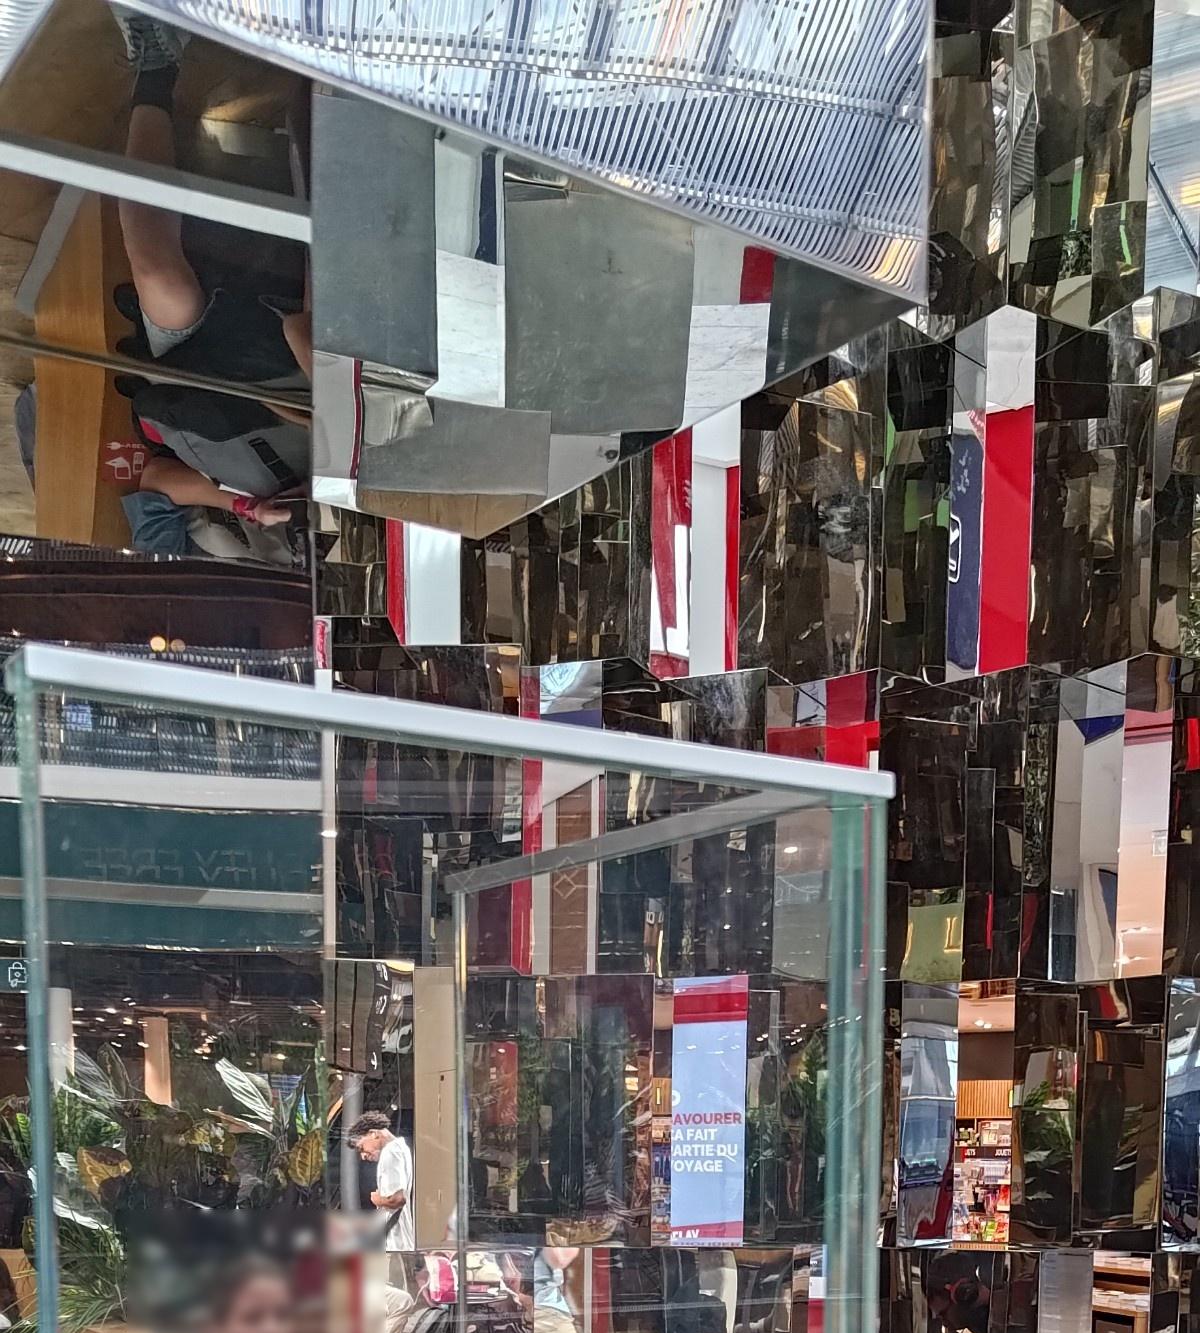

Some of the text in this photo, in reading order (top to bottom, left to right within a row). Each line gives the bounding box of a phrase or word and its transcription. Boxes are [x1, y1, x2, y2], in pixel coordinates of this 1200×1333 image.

[672, 1112, 742, 1125] AVOURER
[687, 1128, 717, 1141] FAIT
[671, 1144, 738, 1157] ARTIE DU
